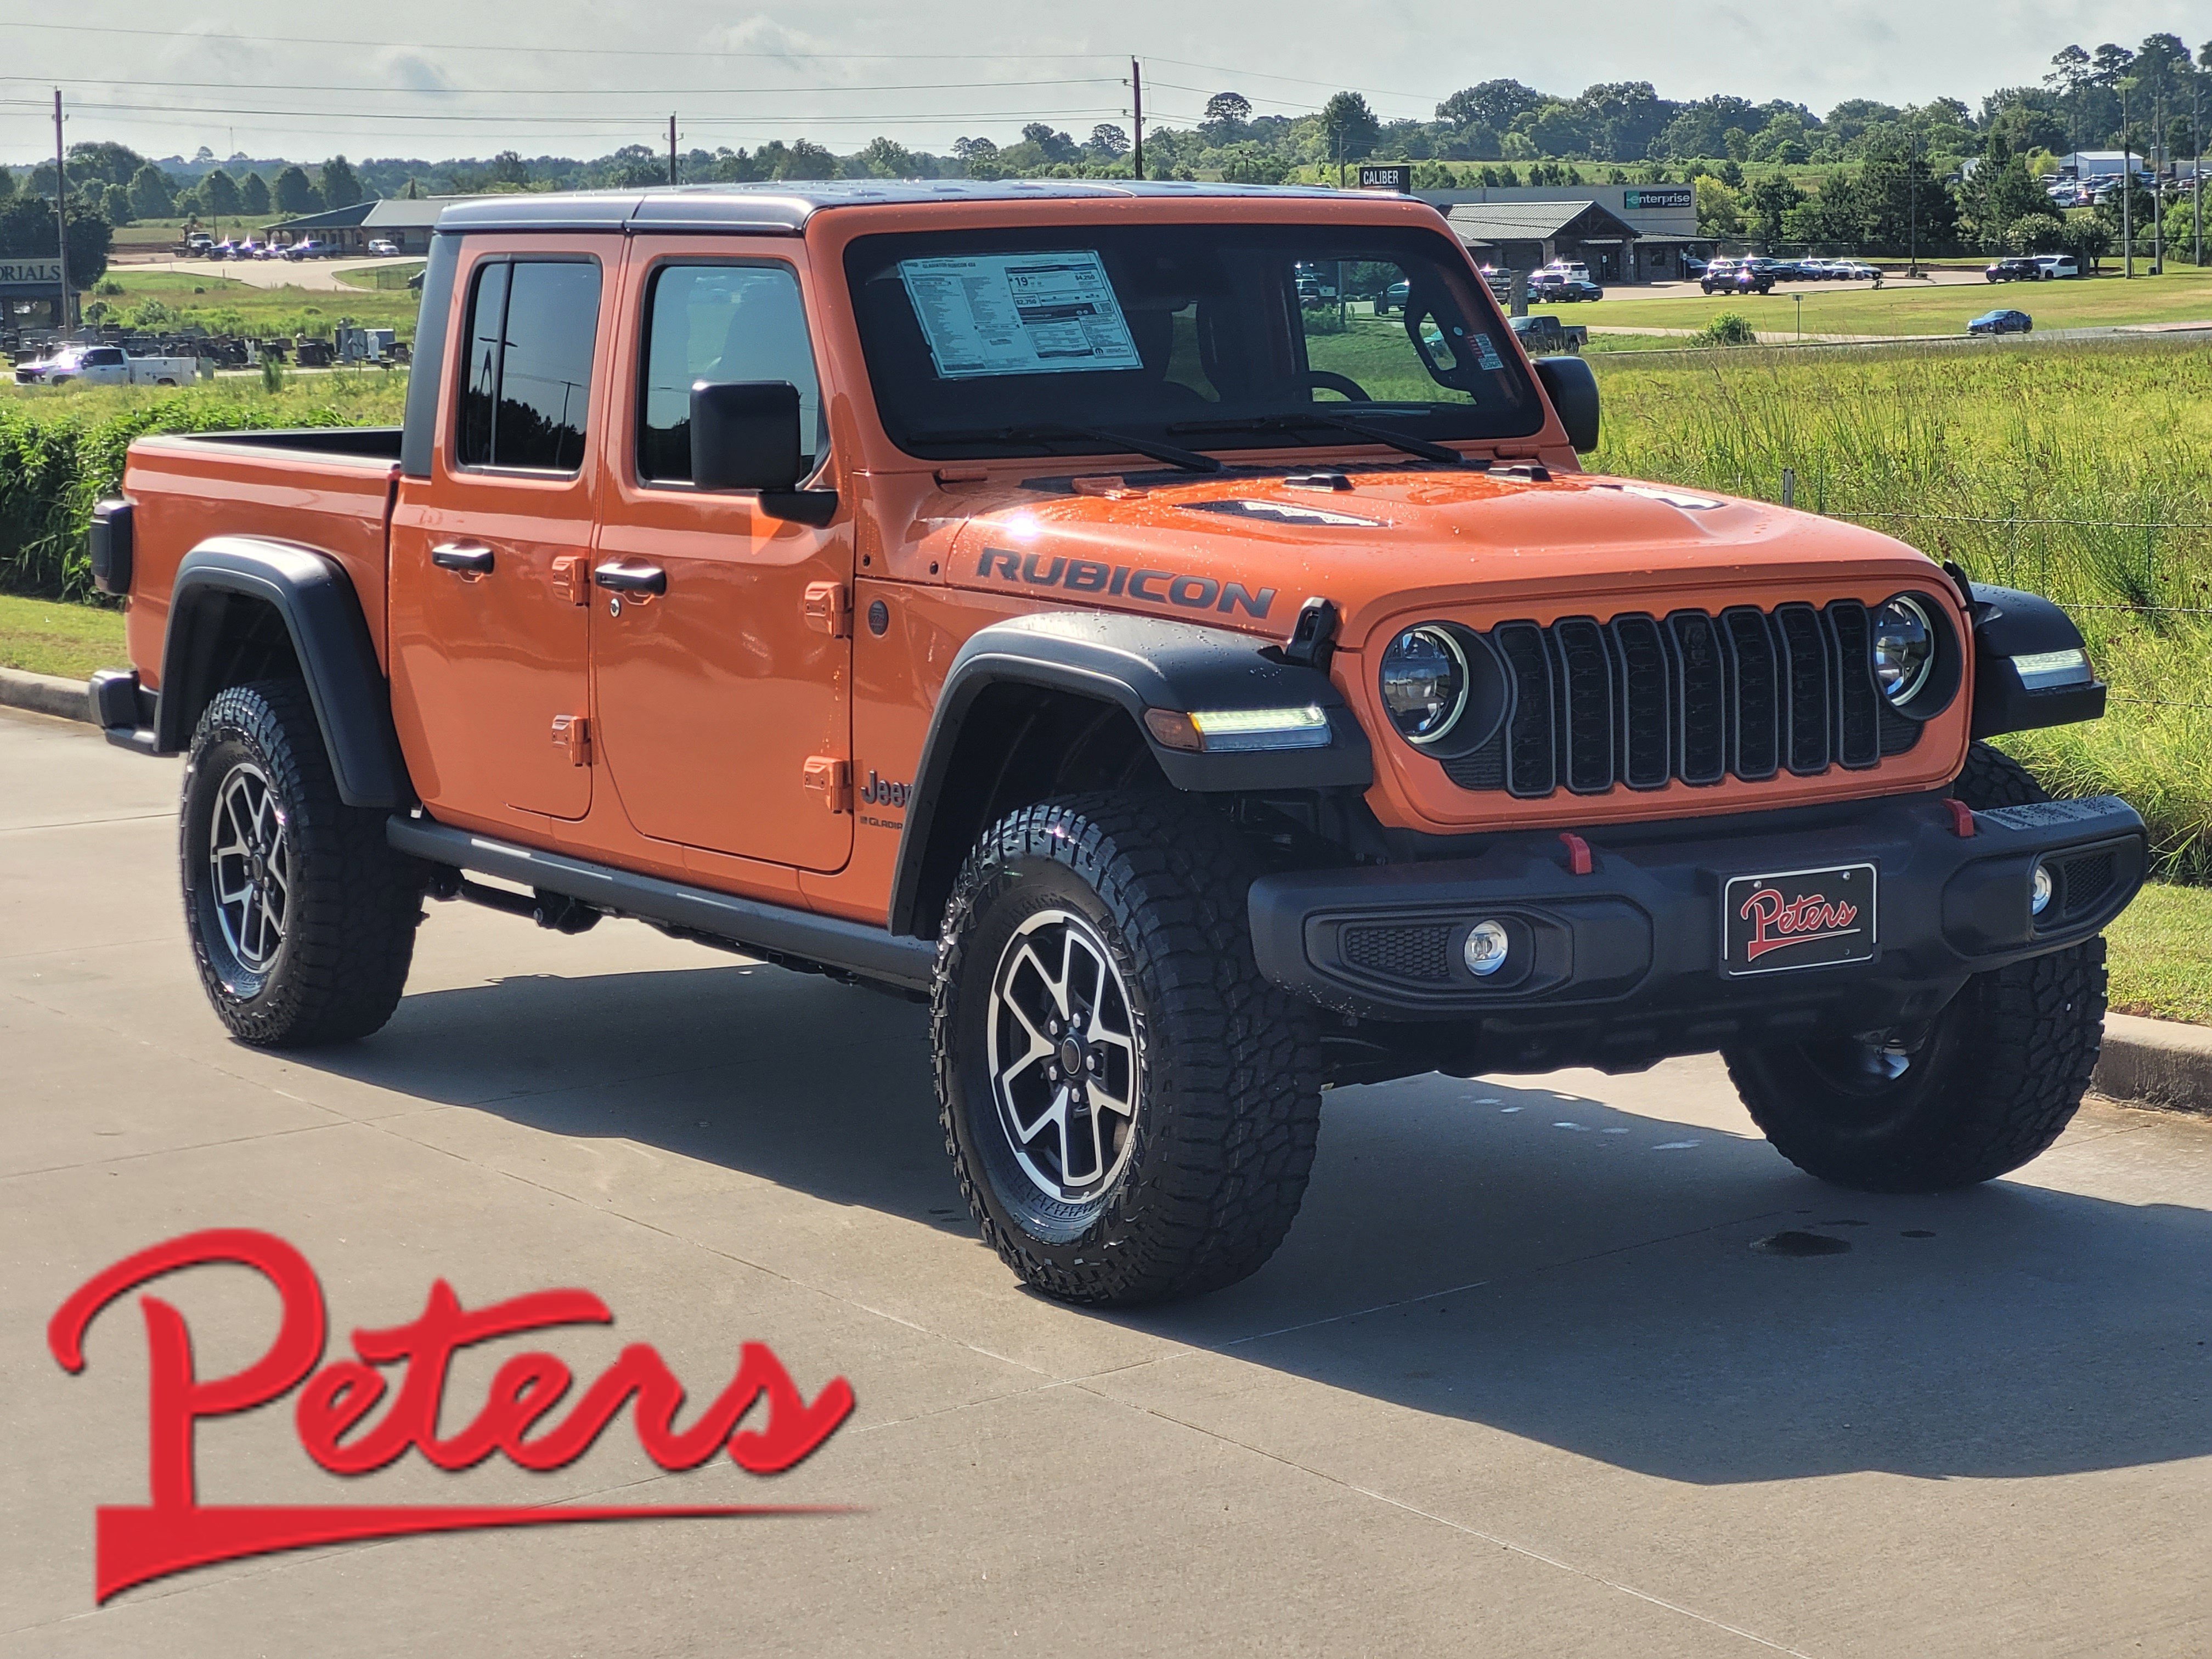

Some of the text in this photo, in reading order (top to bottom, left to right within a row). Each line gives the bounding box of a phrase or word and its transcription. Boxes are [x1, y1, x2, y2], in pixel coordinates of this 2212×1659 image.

[1363, 170, 1398, 184] CALIBER
[1626, 193, 1690, 205] enterprise
[1015, 276, 1028, 286] 19
[976, 546, 1277, 619] RUBICON
[1740, 888, 1858, 944] Peters
